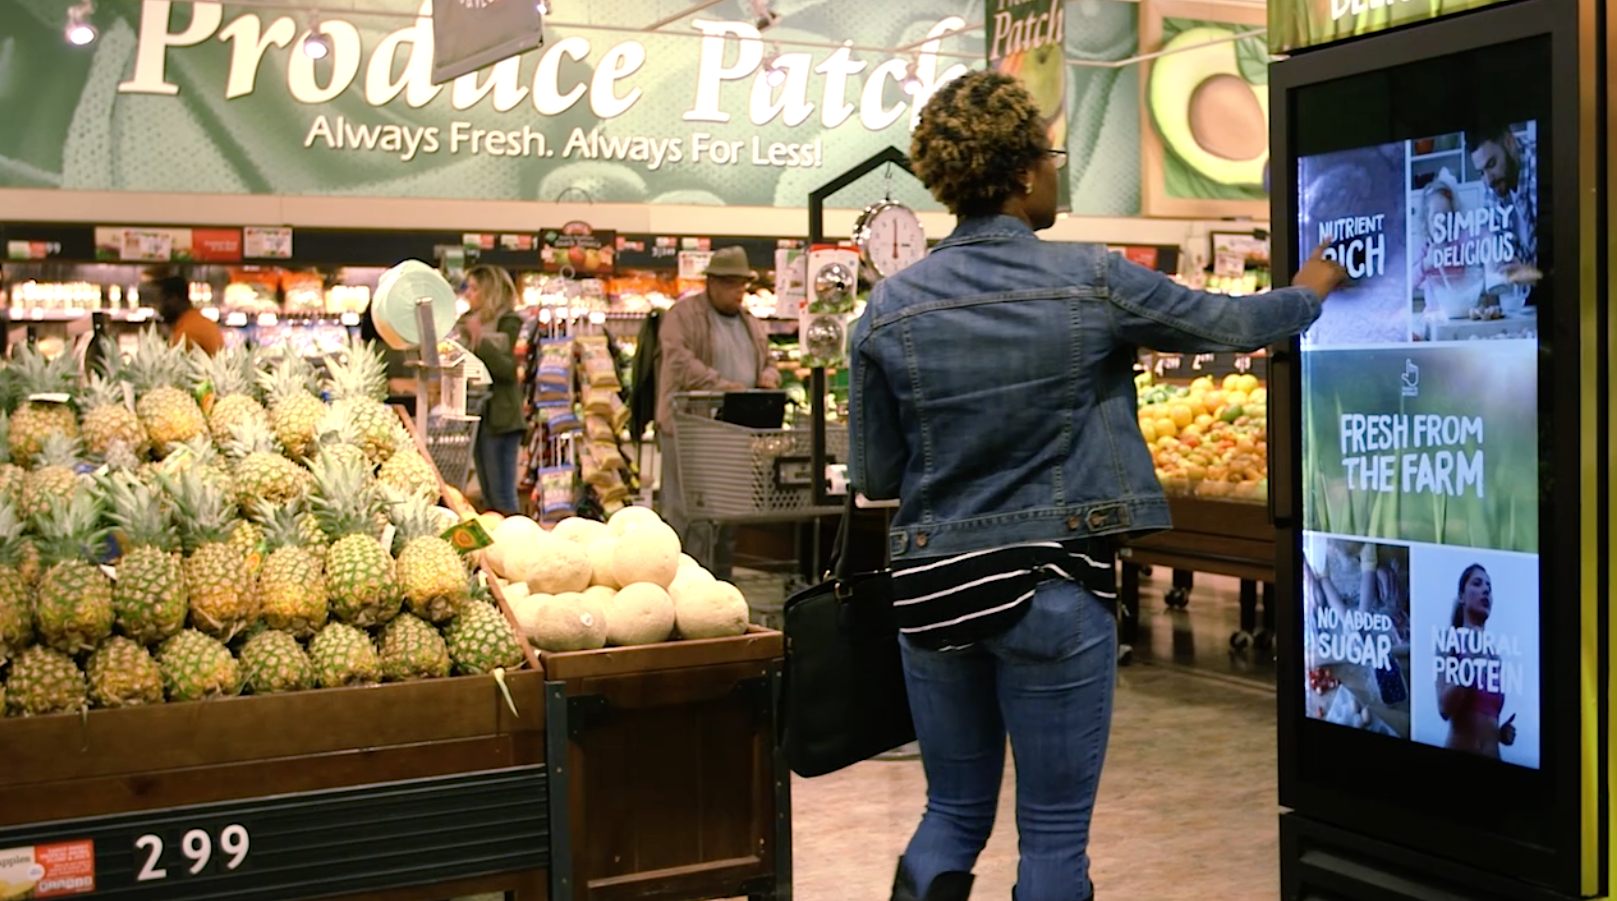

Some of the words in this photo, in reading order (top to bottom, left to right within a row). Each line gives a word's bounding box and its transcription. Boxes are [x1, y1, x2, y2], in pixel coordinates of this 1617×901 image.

[989, 0, 1064, 60] Patch
[117, 0, 646, 118] Produce
[682, 16, 968, 132] Patch
[304, 115, 439, 161] Always
[450, 121, 555, 158] Fresh.
[562, 127, 683, 171] Always
[690, 132, 744, 166] For
[751, 135, 823, 168] Less!
[1319, 213, 1385, 246] NUTRIENT
[1432, 204, 1515, 244] SIMPLY
[1341, 413, 1409, 454] FRESH
[1413, 414, 1484, 448] FROM
[1341, 454, 1396, 492] THE
[1402, 450, 1484, 498] FARM
[1317, 606, 1338, 630] NO
[1342, 609, 1392, 632] ADDED
[1317, 631, 1392, 672] SUGAR
[1431, 625, 1522, 656] NATURAL
[1433, 656, 1524, 696] PROTEIN
